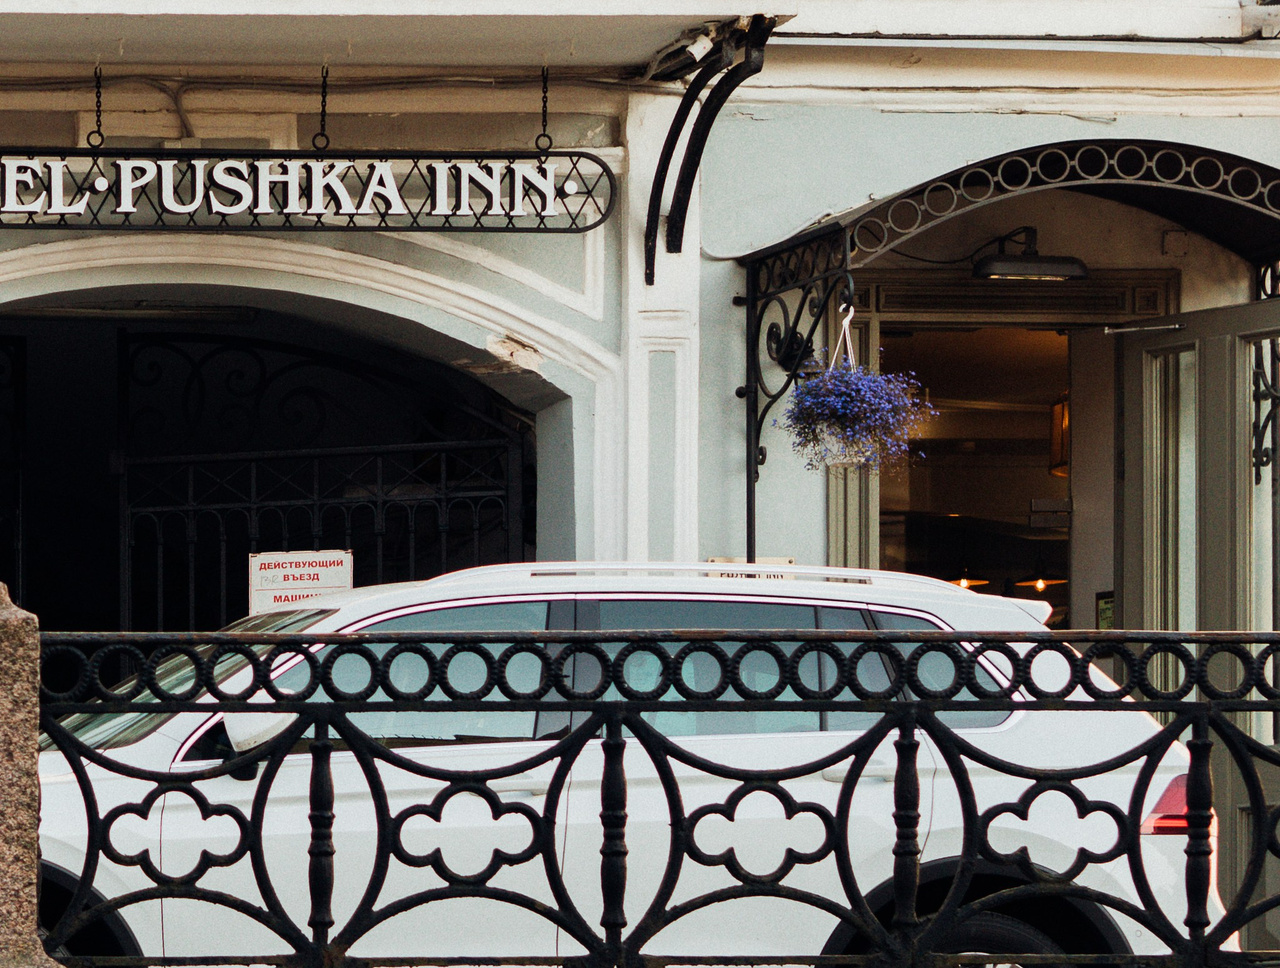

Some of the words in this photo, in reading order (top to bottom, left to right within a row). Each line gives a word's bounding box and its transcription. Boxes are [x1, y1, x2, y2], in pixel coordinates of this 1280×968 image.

[116, 159, 408, 215] PUSHKA
[431, 161, 559, 217] INN
[259, 558, 344, 571] ДЕЙСТВУЮЩИЙ
[283, 573, 320, 582] ВЪЕЗД
[273, 593, 321, 603] МАШ
